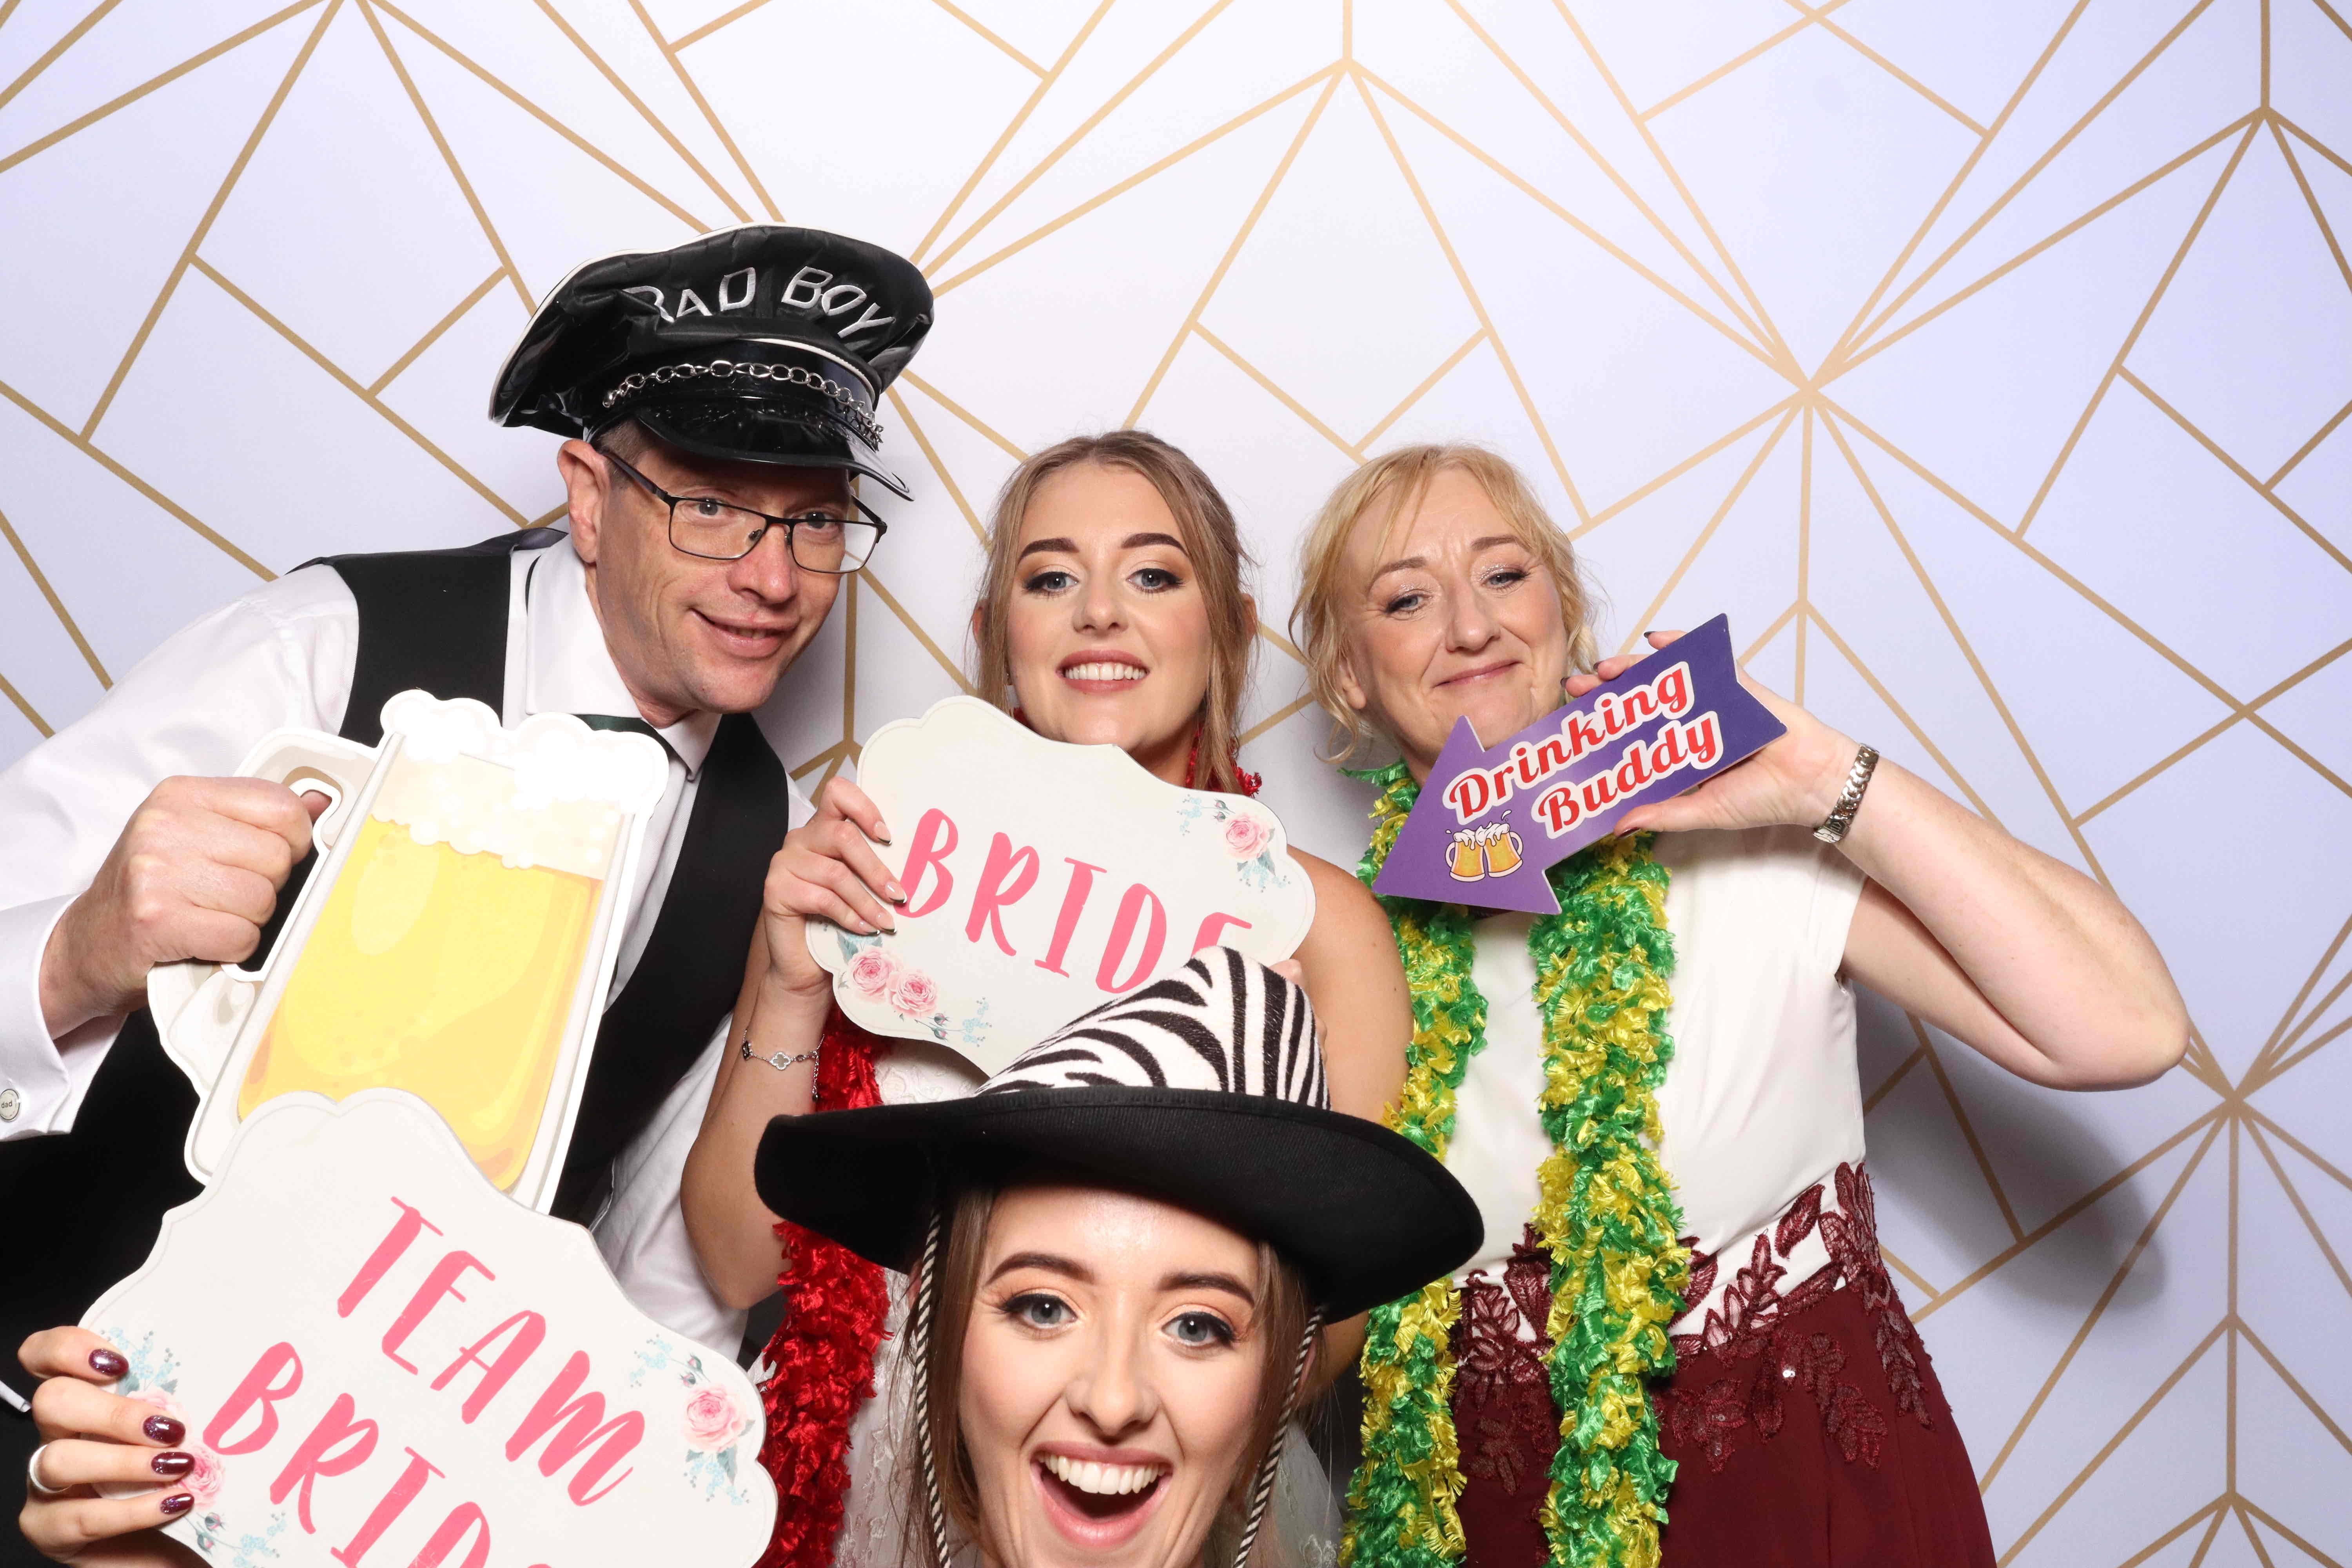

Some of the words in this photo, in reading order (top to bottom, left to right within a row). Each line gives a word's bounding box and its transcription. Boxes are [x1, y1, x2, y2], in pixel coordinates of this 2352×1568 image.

[781, 265, 895, 338] BOY
[1449, 668, 1688, 818] Drinking
[1537, 718, 1717, 832] Buddy
[1, 1100, 13, 1109] dad
[338, 1196, 645, 1507] TEAM
[202, 1341, 552, 1568] BRID
